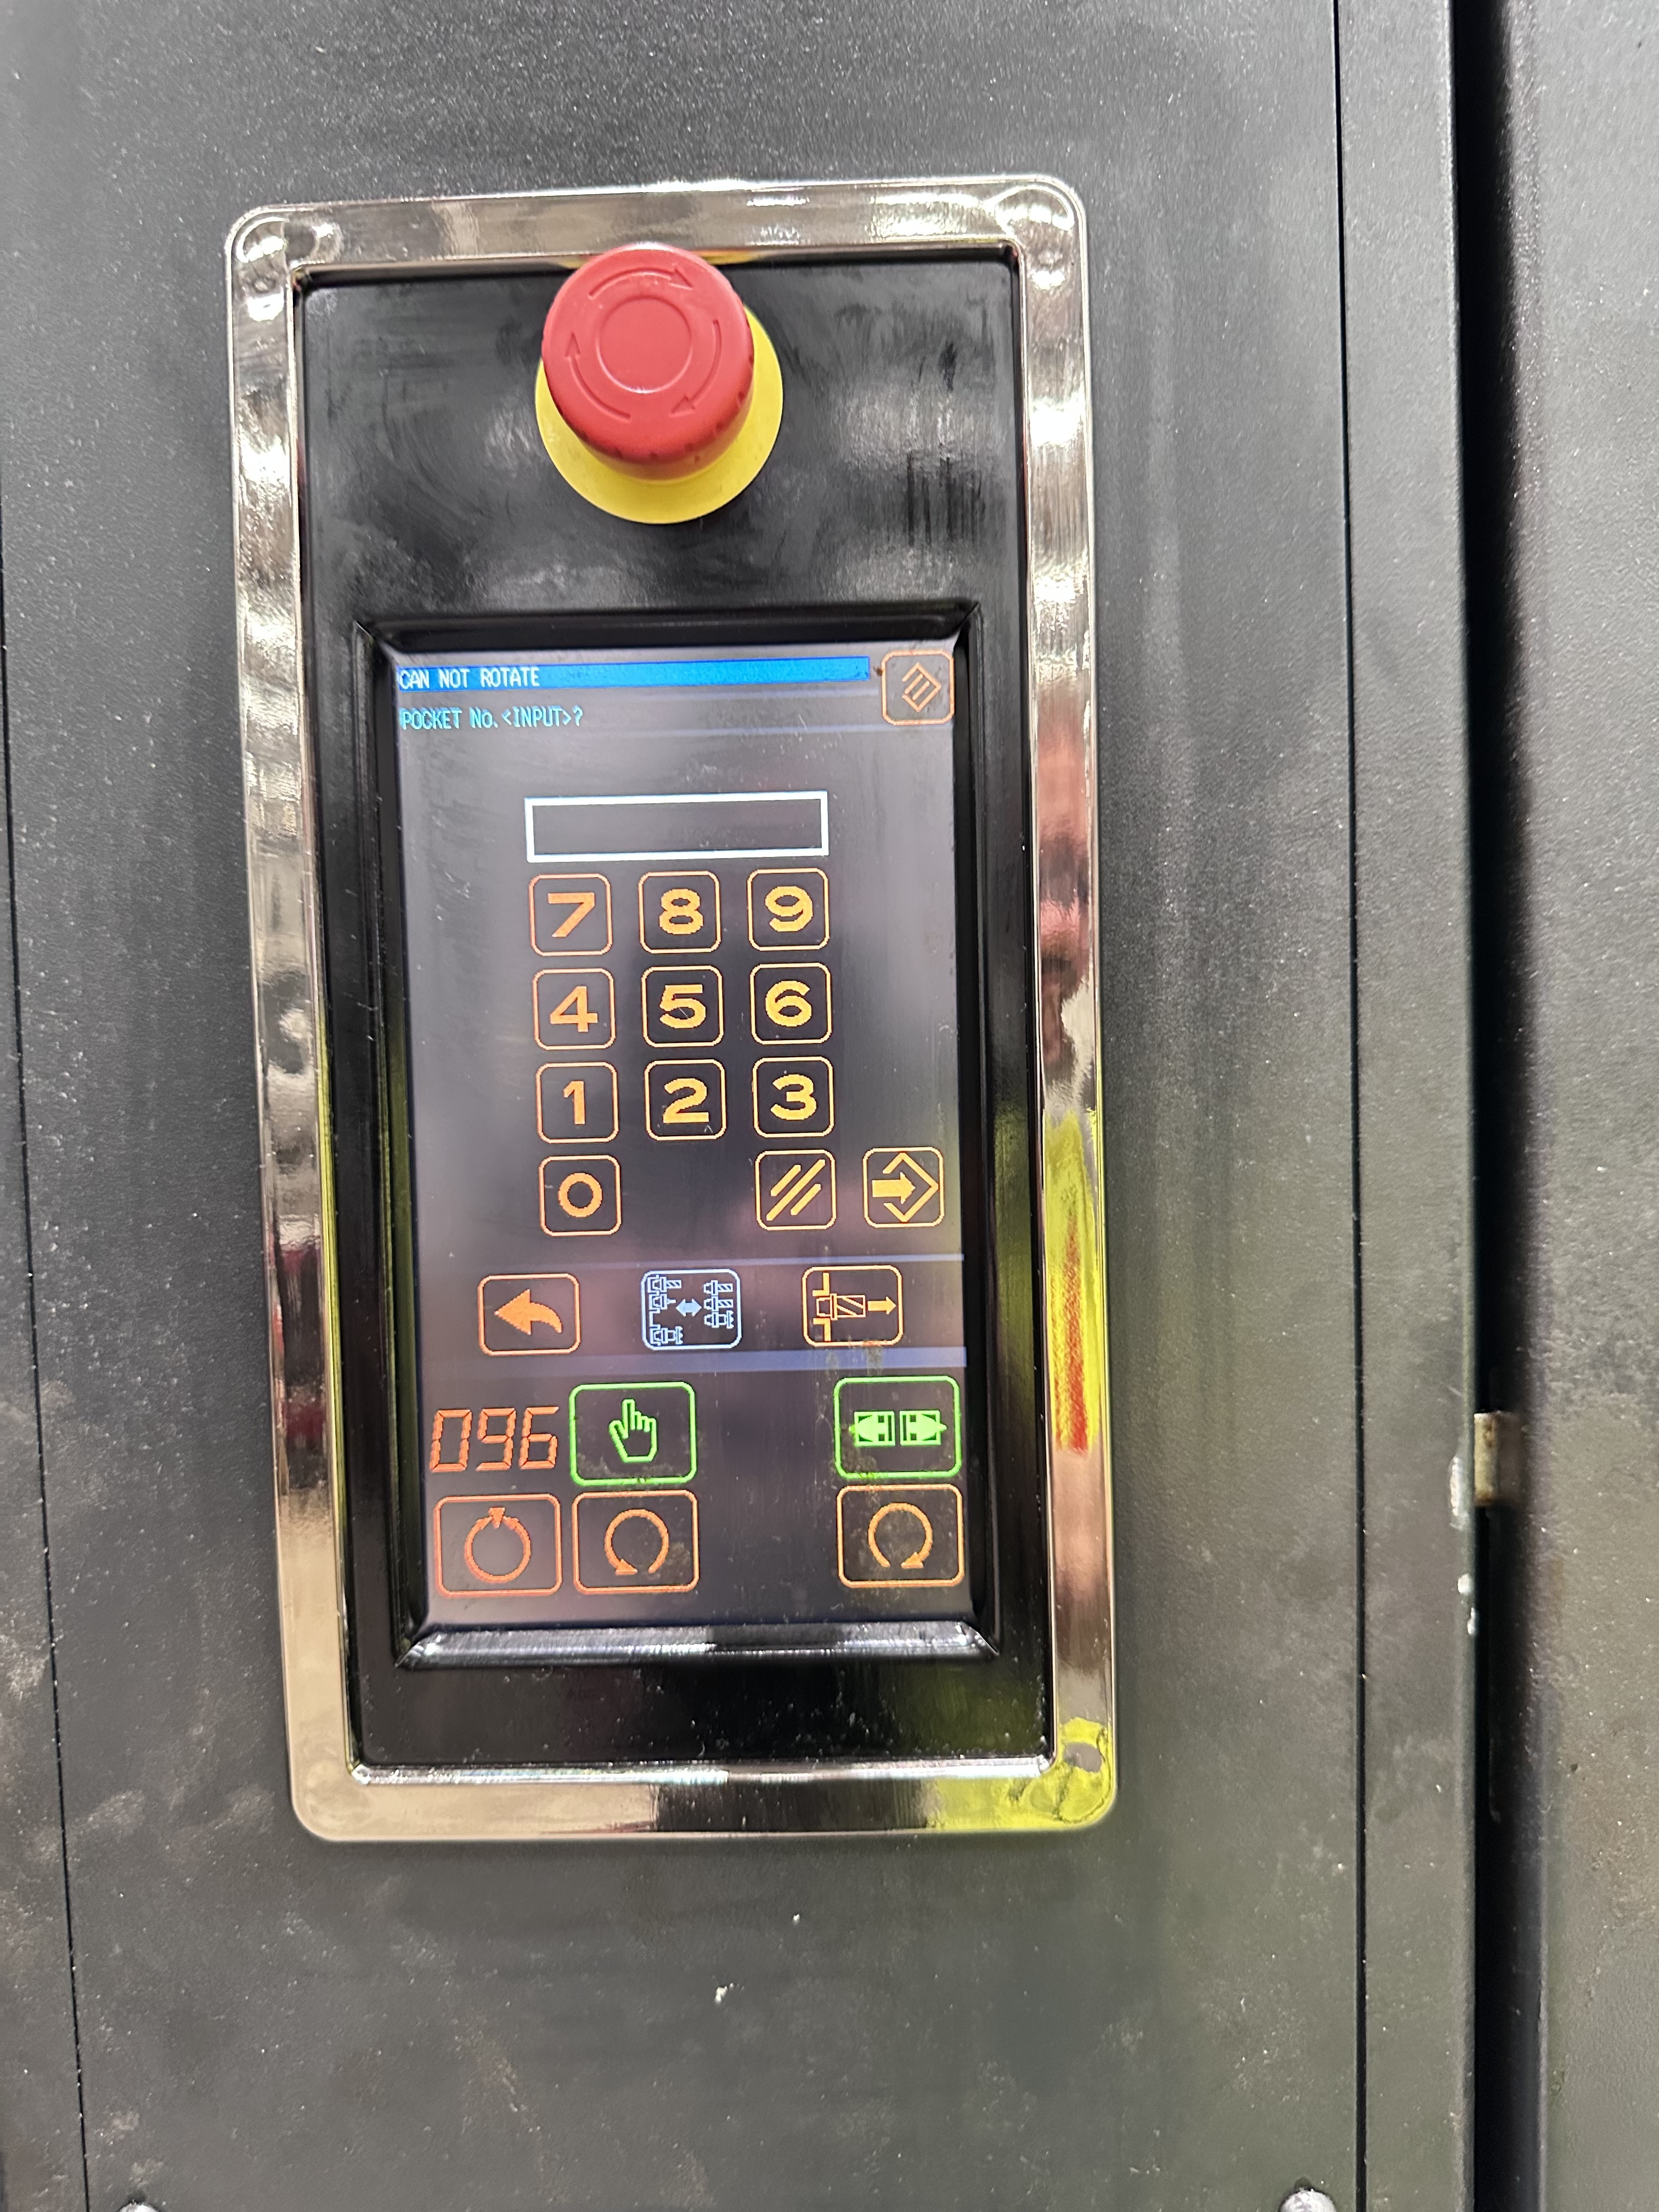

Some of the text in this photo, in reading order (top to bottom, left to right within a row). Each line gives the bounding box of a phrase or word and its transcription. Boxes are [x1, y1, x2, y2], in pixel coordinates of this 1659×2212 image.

[399, 667, 540, 690] CAN NOT ROTATE
[400, 707, 462, 730] POCKET
[548, 886, 814, 938] 7 8 9
[550, 980, 812, 1032] 4 5 6
[563, 1074, 816, 1125] 1 2 3
[430, 1406, 559, 1472] 096
